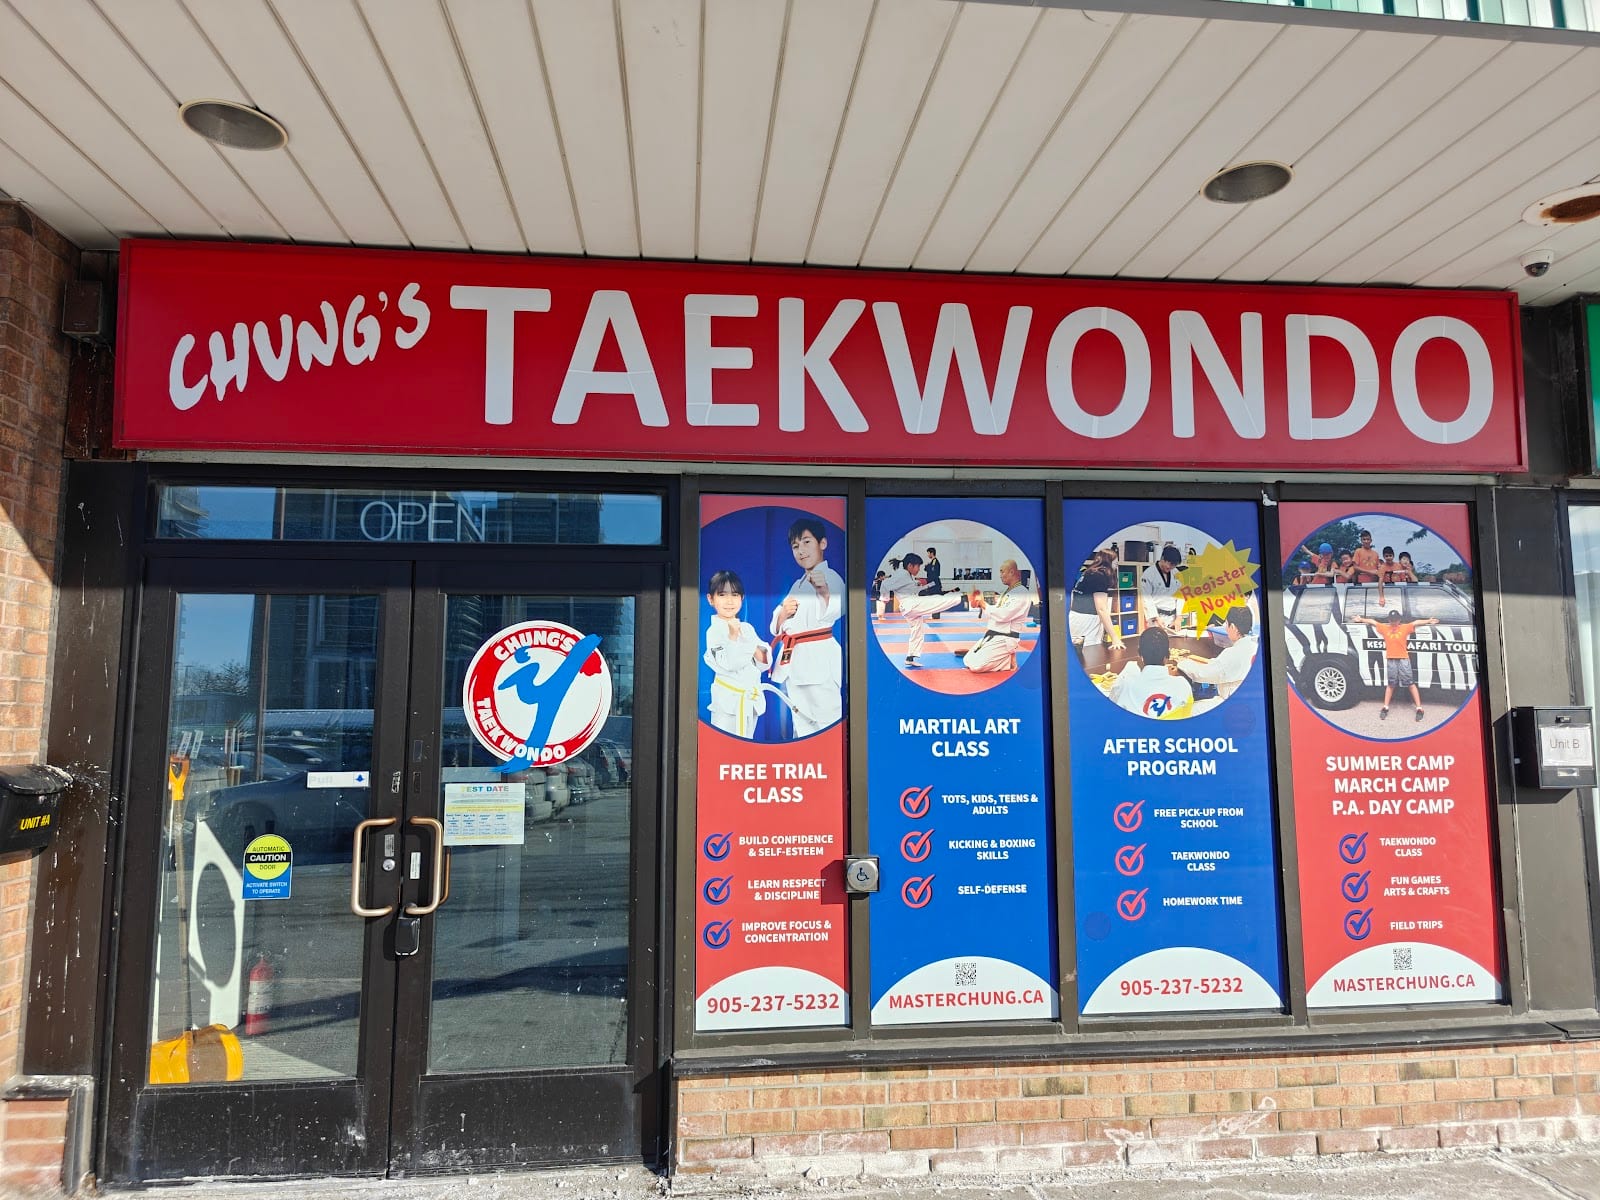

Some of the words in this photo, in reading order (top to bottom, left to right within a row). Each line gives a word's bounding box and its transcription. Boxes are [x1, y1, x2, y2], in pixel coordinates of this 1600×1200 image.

[168, 282, 431, 410] CHUNG'S
[450, 285, 1494, 444] TAEKWONDO
[360, 501, 486, 542] OPEN
[1180, 565, 1246, 602] Register
[1200, 584, 1244, 614] Now!
[493, 630, 577, 661] CHUNG'S
[476, 697, 566, 762] TAEKWONDO
[900, 719, 981, 735] MARTIAL
[984, 719, 1021, 735] ART
[1104, 739, 1161, 755] AFTER
[1165, 738, 1239, 754] SCHOOL
[1549, 738, 1570, 749] Unit
[1572, 738, 1580, 749] B
[932, 741, 990, 758] CLASS
[1128, 760, 1217, 776] PROGRAM
[1326, 756, 1403, 772] SUMMER
[1407, 756, 1455, 771] CAMP
[720, 764, 768, 781] FREE
[772, 764, 828, 780] TRIAL
[461, 785, 483, 793] TEST
[1335, 778, 1397, 794] MARCH
[1401, 777, 1450, 793] CAMP
[744, 787, 804, 804] CLASS
[942, 795, 970, 805] TOTS,
[972, 794, 998, 805] KIDS,
[999, 794, 1030, 803] TEENS
[1031, 794, 1038, 803] &
[973, 806, 1009, 815] ADULTS
[1154, 809, 1178, 818] FREE
[1179, 808, 1216, 817] PICK-UP
[1218, 808, 1244, 817] FROM
[1333, 800, 1365, 816] P.A.
[1369, 800, 1403, 815] DAY
[1406, 799, 1455, 815] CAMP
[20, 816, 41, 831] UNIT
[40, 814, 51, 827] #A
[1181, 820, 1219, 829] SCHOOL
[739, 836, 770, 846] BUILD
[771, 835, 834, 845] CONFIDENCE
[949, 840, 989, 849] KICKING
[990, 840, 997, 849] &
[1000, 839, 1036, 849] BOXING
[1380, 837, 1437, 846] TAEKWONDO
[749, 848, 756, 857] &
[759, 847, 824, 857] SELF-ESTEEM
[977, 851, 1009, 861] SKILLS
[1171, 851, 1231, 861] TAEKWONDO
[1395, 848, 1423, 857] CLASS
[249, 854, 287, 862] CAUTION
[1187, 863, 1216, 872] CLASS
[748, 880, 777, 889] LEARN
[780, 879, 826, 889] RESPECT
[1391, 877, 1410, 885] FUN
[1411, 876, 1442, 885] GAMES
[958, 885, 1027, 895] SELF-DEFENSE
[1384, 888, 1407, 897] ARTS
[1408, 888, 1415, 896] &
[1417, 887, 1450, 896] CRAFTS
[754, 892, 762, 901] &
[765, 891, 820, 901] DISCIPLINE
[1163, 897, 1219, 907] HOMEWORK
[1220, 896, 1243, 906] TIME
[742, 922, 788, 932] IMPROVE
[789, 921, 824, 930] FOCUS
[824, 920, 831, 930] &
[1390, 922, 1416, 931] FIELD
[1417, 921, 1444, 930] TRIPS
[745, 932, 830, 943] CONCENTRATION
[1120, 977, 1244, 997] 905-237-5232
[1333, 975, 1476, 993] MASTERCHUNG.CA
[707, 993, 840, 1015] 905-237-5232
[889, 990, 1044, 1009] MASTERCHUNG.CA
